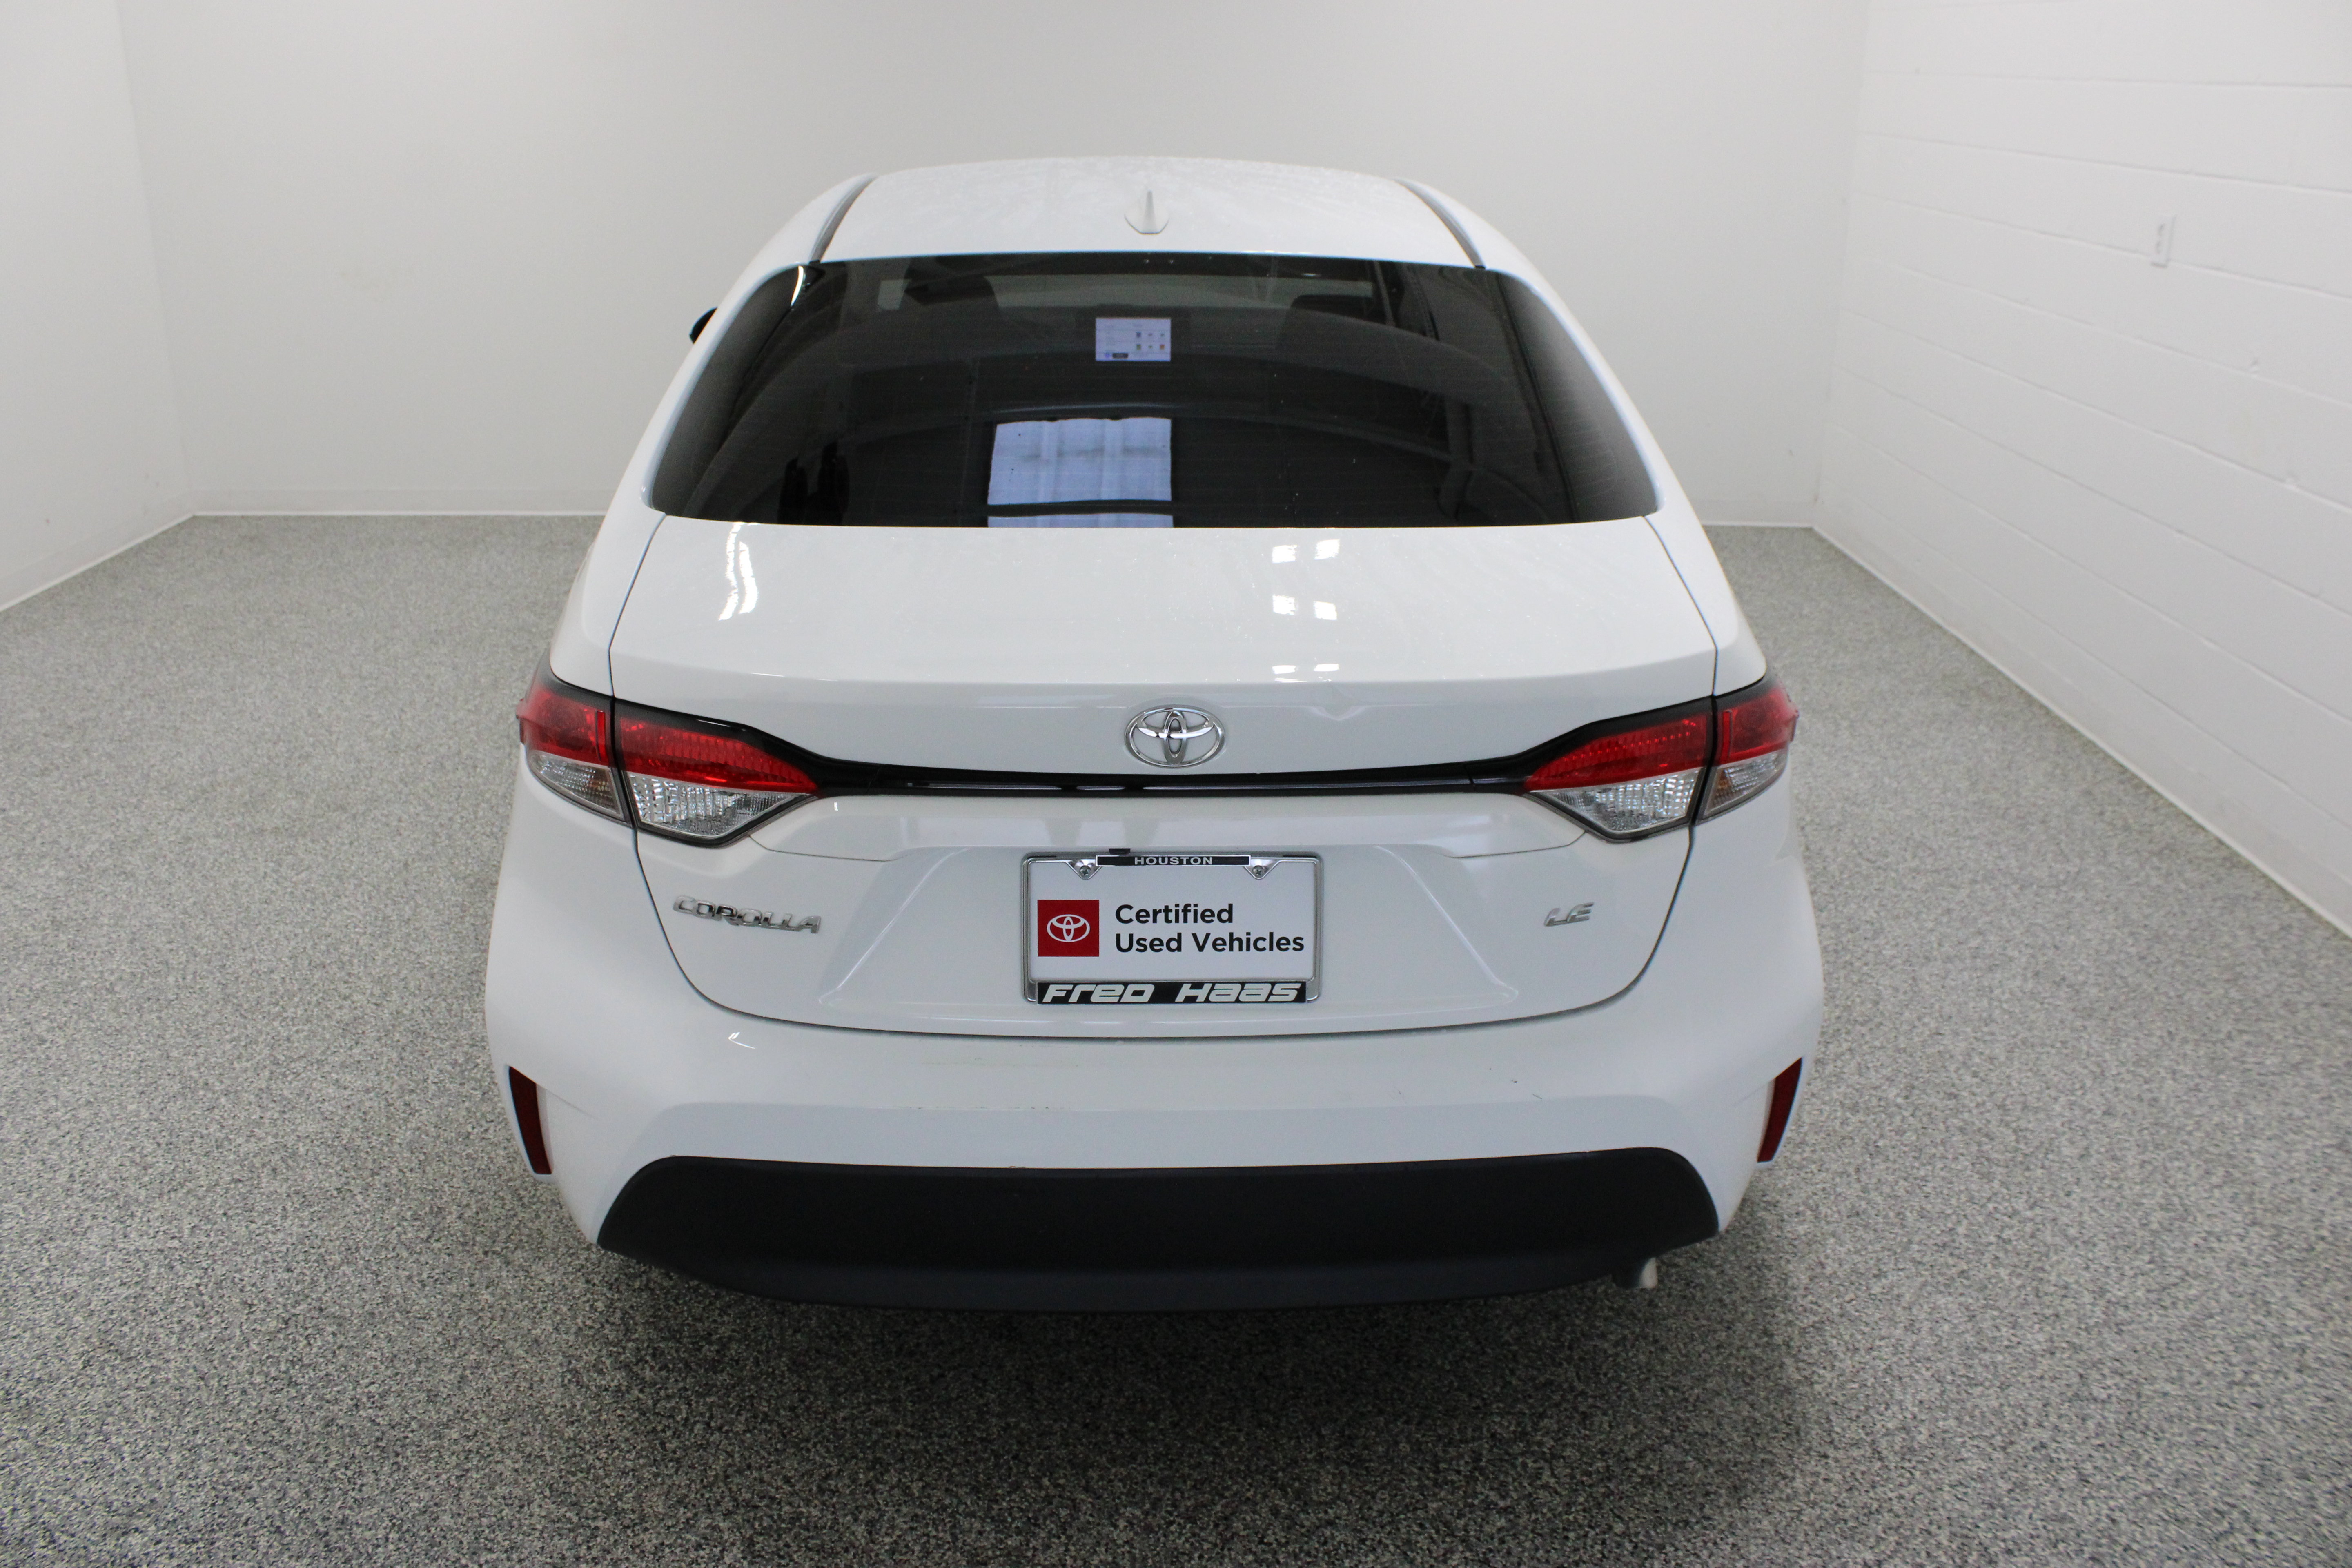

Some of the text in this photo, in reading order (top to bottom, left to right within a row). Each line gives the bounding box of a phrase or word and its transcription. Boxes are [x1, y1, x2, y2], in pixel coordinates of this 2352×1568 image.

[1134, 856, 1213, 865] HOUSTON
[673, 895, 822, 934] COROLLA
[1115, 904, 1234, 924] Certified
[1544, 902, 1595, 927] LE
[1116, 932, 1304, 953] Used Vehicles
